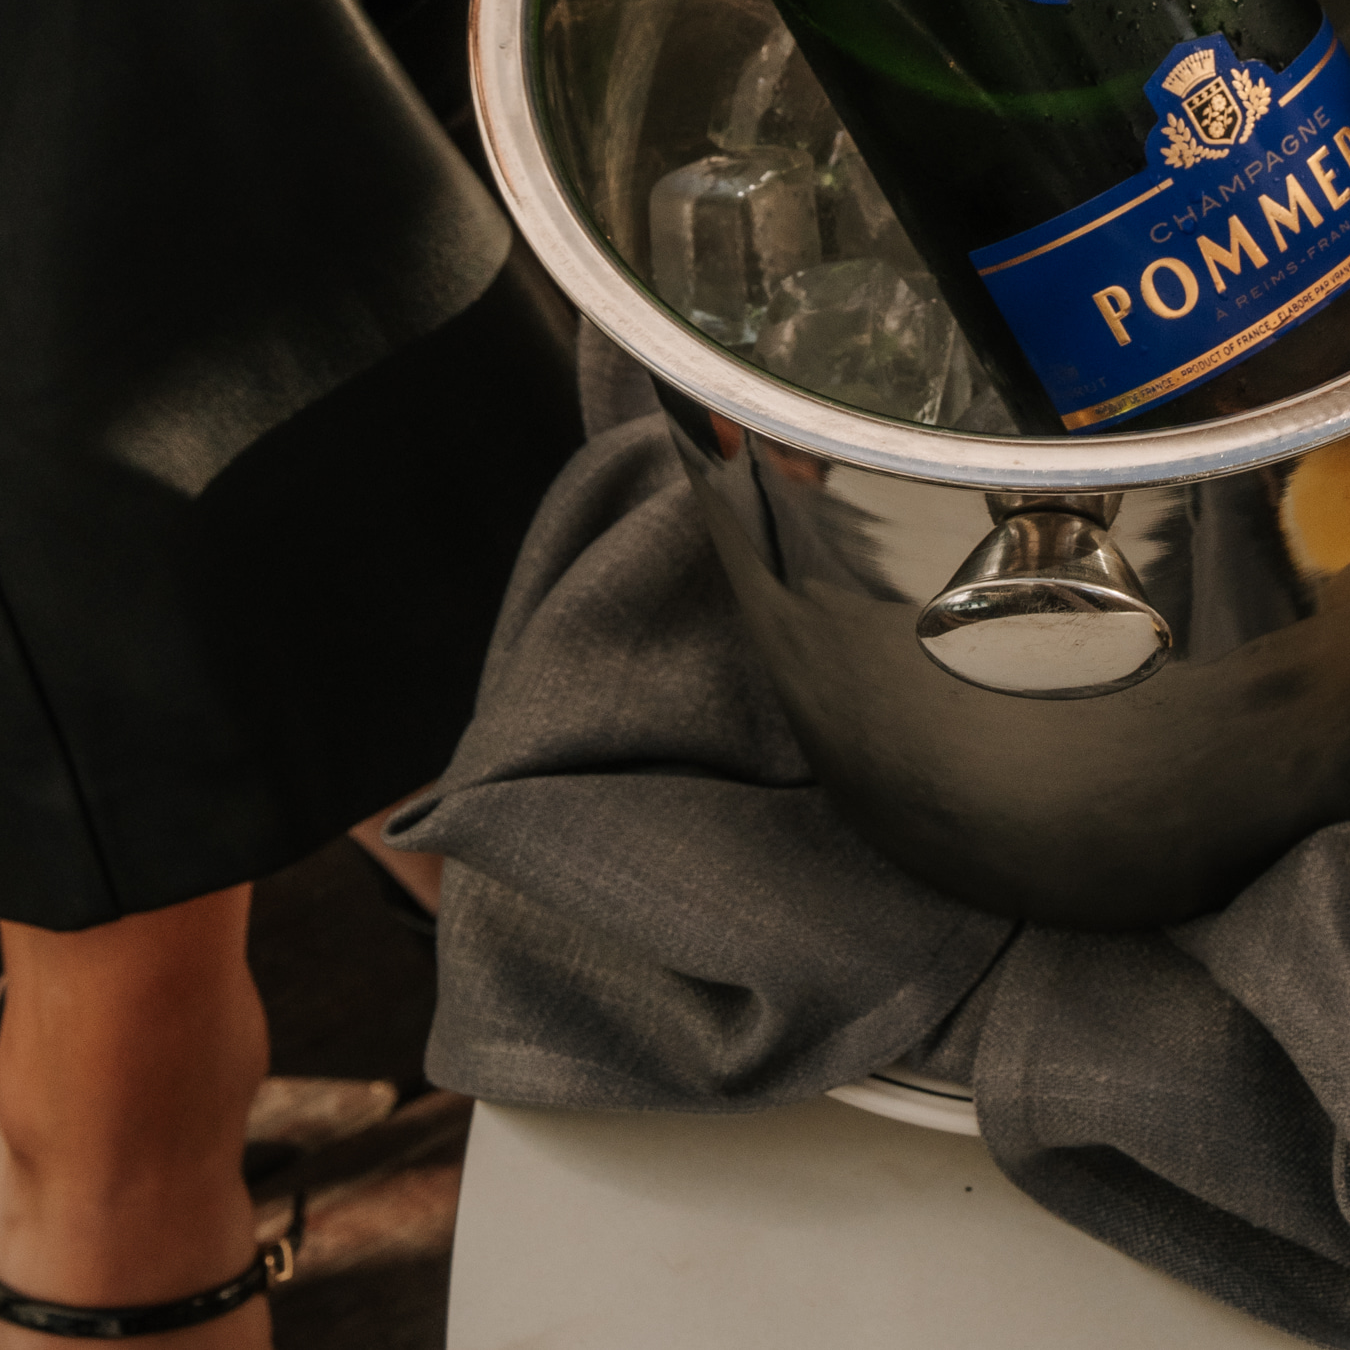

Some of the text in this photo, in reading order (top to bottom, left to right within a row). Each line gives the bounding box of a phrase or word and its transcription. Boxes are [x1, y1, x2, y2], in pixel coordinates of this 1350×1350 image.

[1150, 106, 1331, 243] CHAMPAGNE
[1140, 376, 1175, 398] FRANCE
[1181, 351, 1222, 377] PRODUCT
[1223, 343, 1235, 356] OF
[1236, 321, 1271, 347] FRANCE
